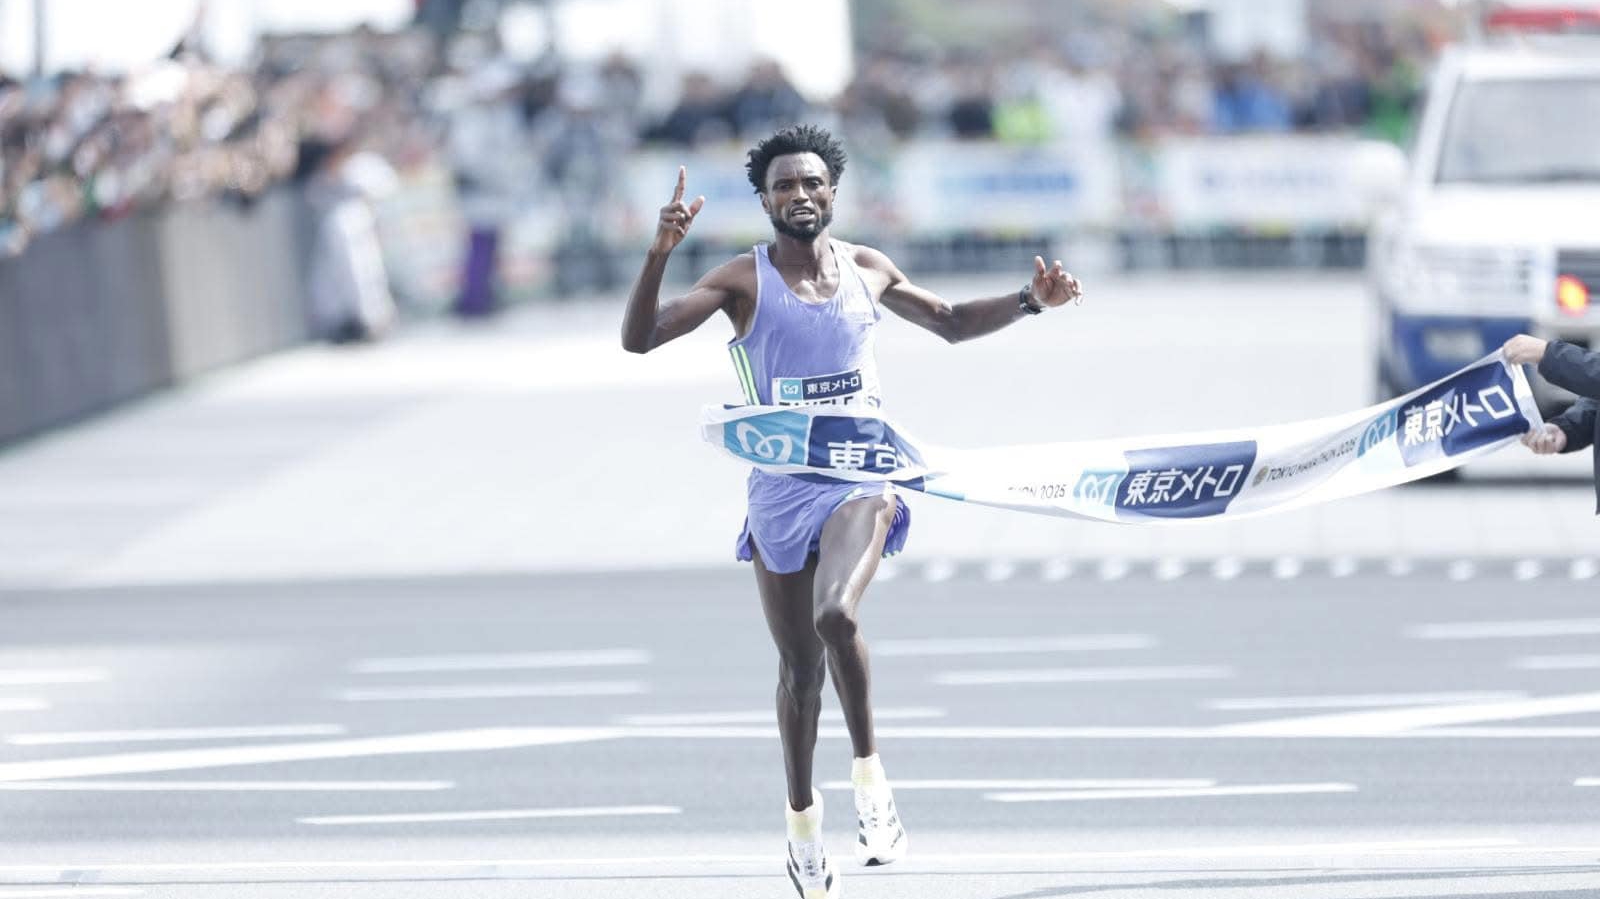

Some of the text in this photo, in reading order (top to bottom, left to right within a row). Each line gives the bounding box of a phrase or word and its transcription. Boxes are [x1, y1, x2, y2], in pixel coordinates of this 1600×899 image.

[806, 376, 859, 395] 東京メトロ
[1403, 384, 1517, 447] 東京メトロ
[1266, 464, 1298, 483] TOKYO
[1040, 483, 1067, 499] 2025
[1123, 464, 1245, 506] 東京メトロ
